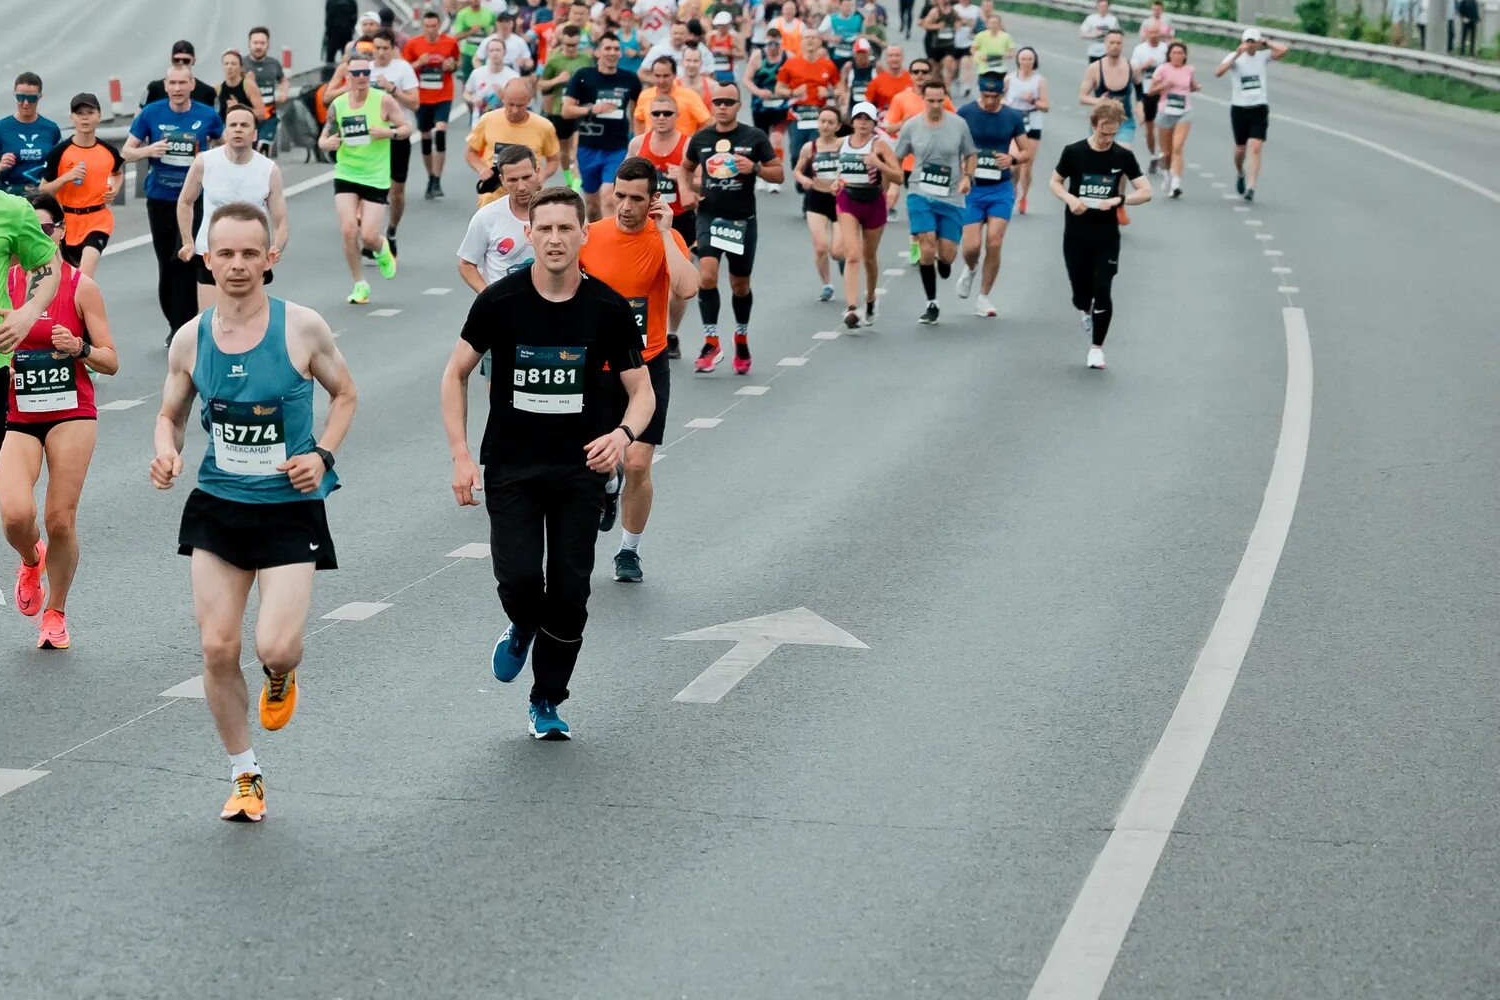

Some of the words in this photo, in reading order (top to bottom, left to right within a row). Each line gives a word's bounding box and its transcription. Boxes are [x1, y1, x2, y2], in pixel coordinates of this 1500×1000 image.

[26, 366, 70, 385] 5128
[527, 367, 576, 385] 8181
[224, 422, 278, 443] 5774
[225, 444, 272, 454] АЛЕКСАНДР
